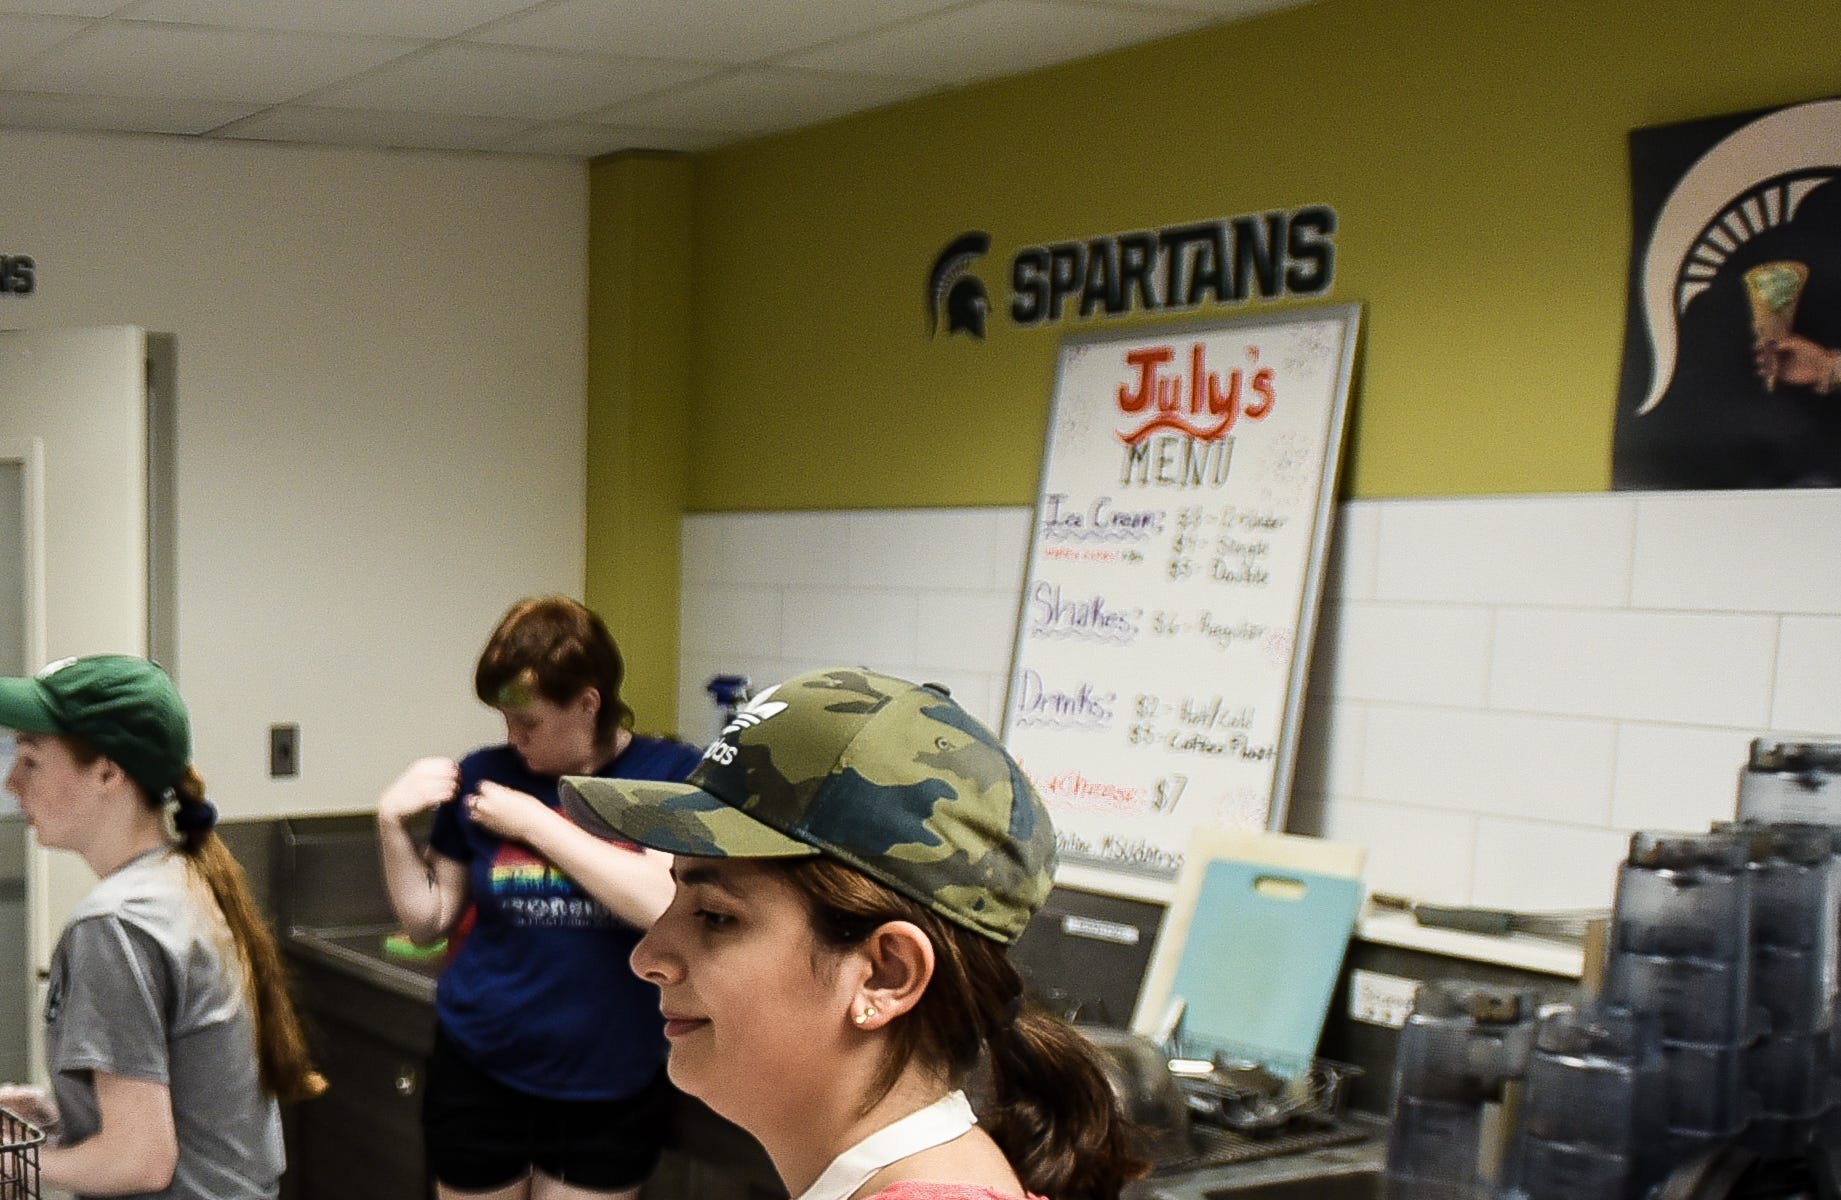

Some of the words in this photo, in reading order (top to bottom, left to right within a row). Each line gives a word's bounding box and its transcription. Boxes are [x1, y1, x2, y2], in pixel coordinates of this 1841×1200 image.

[1010, 205, 1338, 327] SPARTANS
[1117, 342, 1276, 444] July's
[1121, 436, 1236, 488] MENU
